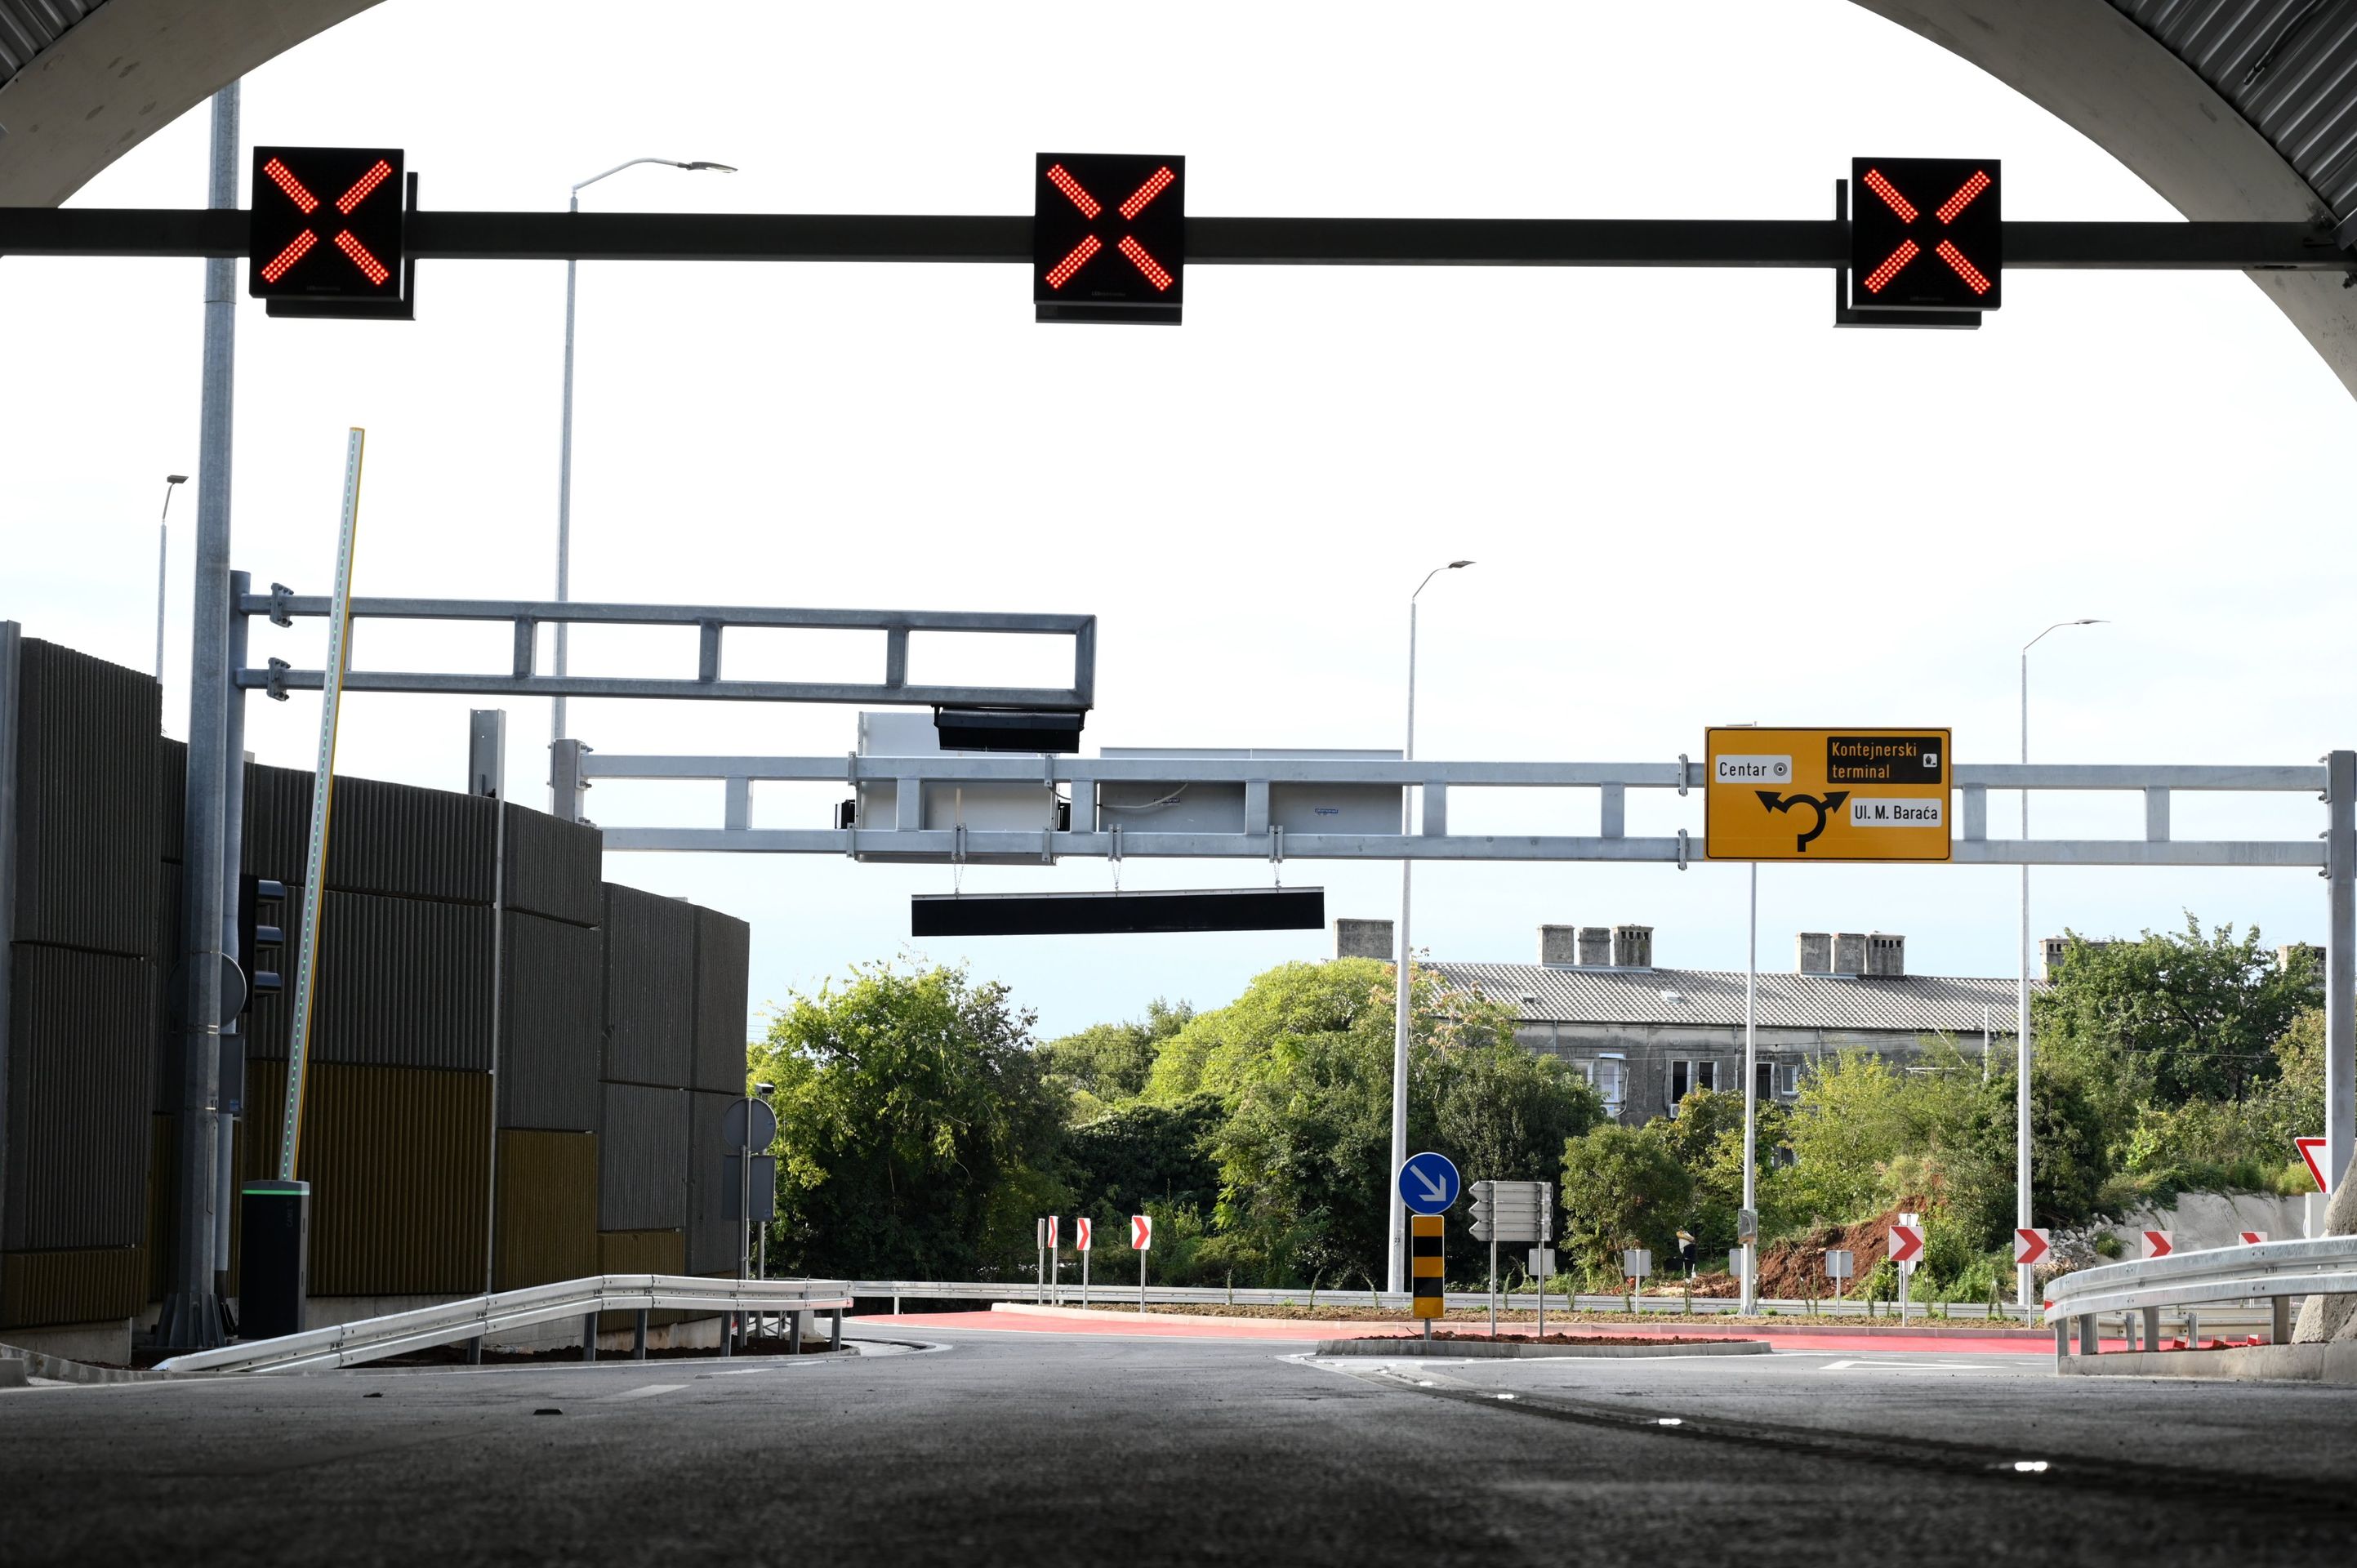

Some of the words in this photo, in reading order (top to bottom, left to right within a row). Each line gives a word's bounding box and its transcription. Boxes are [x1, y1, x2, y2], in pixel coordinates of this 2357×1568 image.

[1832, 742, 1917, 760] Kontejnerski
[1719, 761, 1767, 777] Centar
[1832, 764, 1890, 778] terminal
[1855, 804, 1871, 820] Ul.
[1874, 804, 1890, 820] M.
[1893, 805, 1938, 820] Baraća
